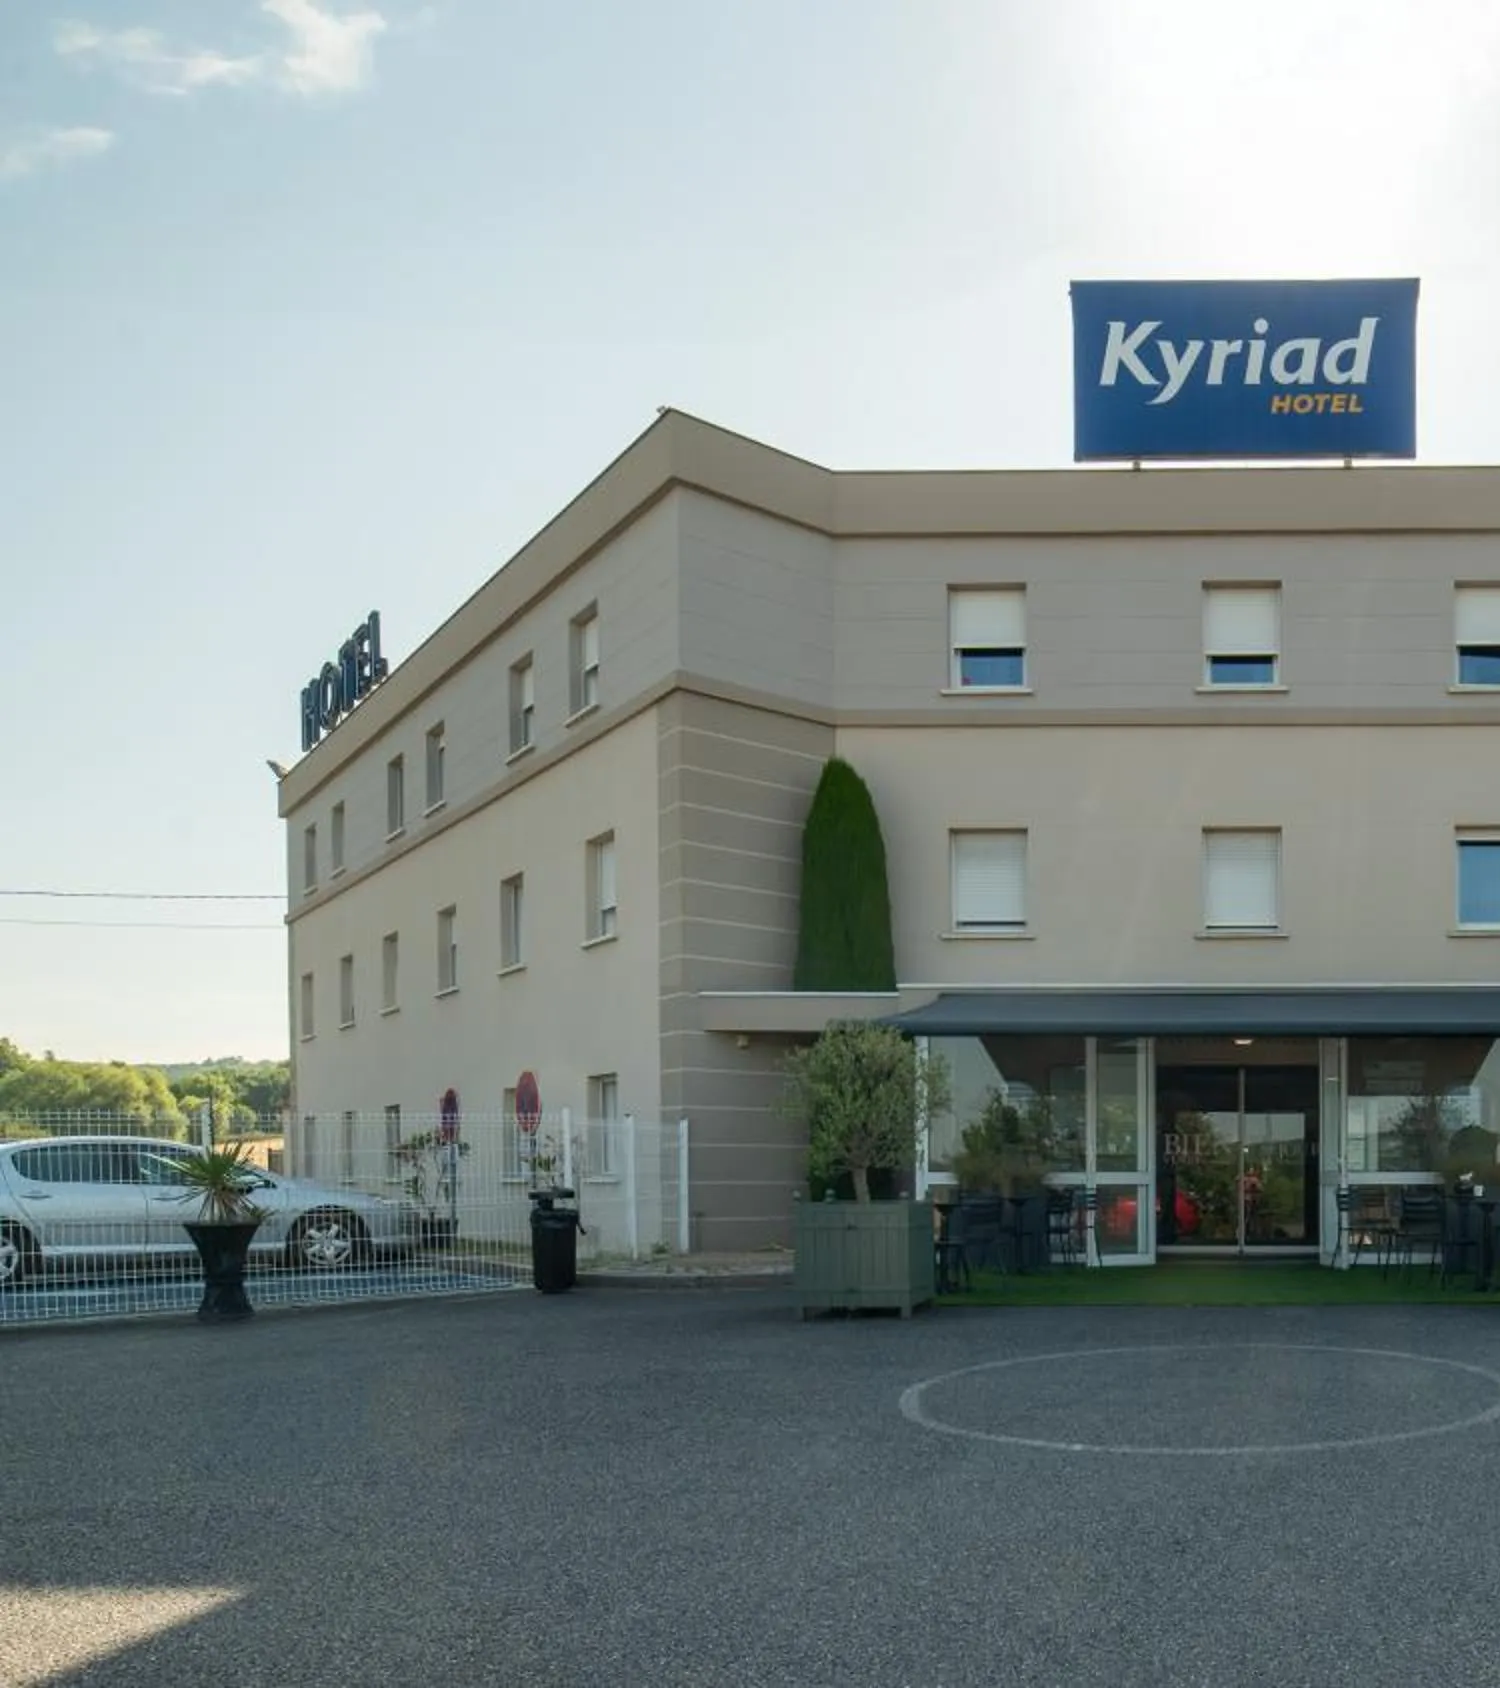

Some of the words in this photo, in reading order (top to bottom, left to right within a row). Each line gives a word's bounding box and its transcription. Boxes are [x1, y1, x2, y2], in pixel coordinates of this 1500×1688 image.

[1100, 317, 1380, 405] Kyriad
[1271, 393, 1363, 415] HOTEL
[301, 609, 388, 752] HOTEL
